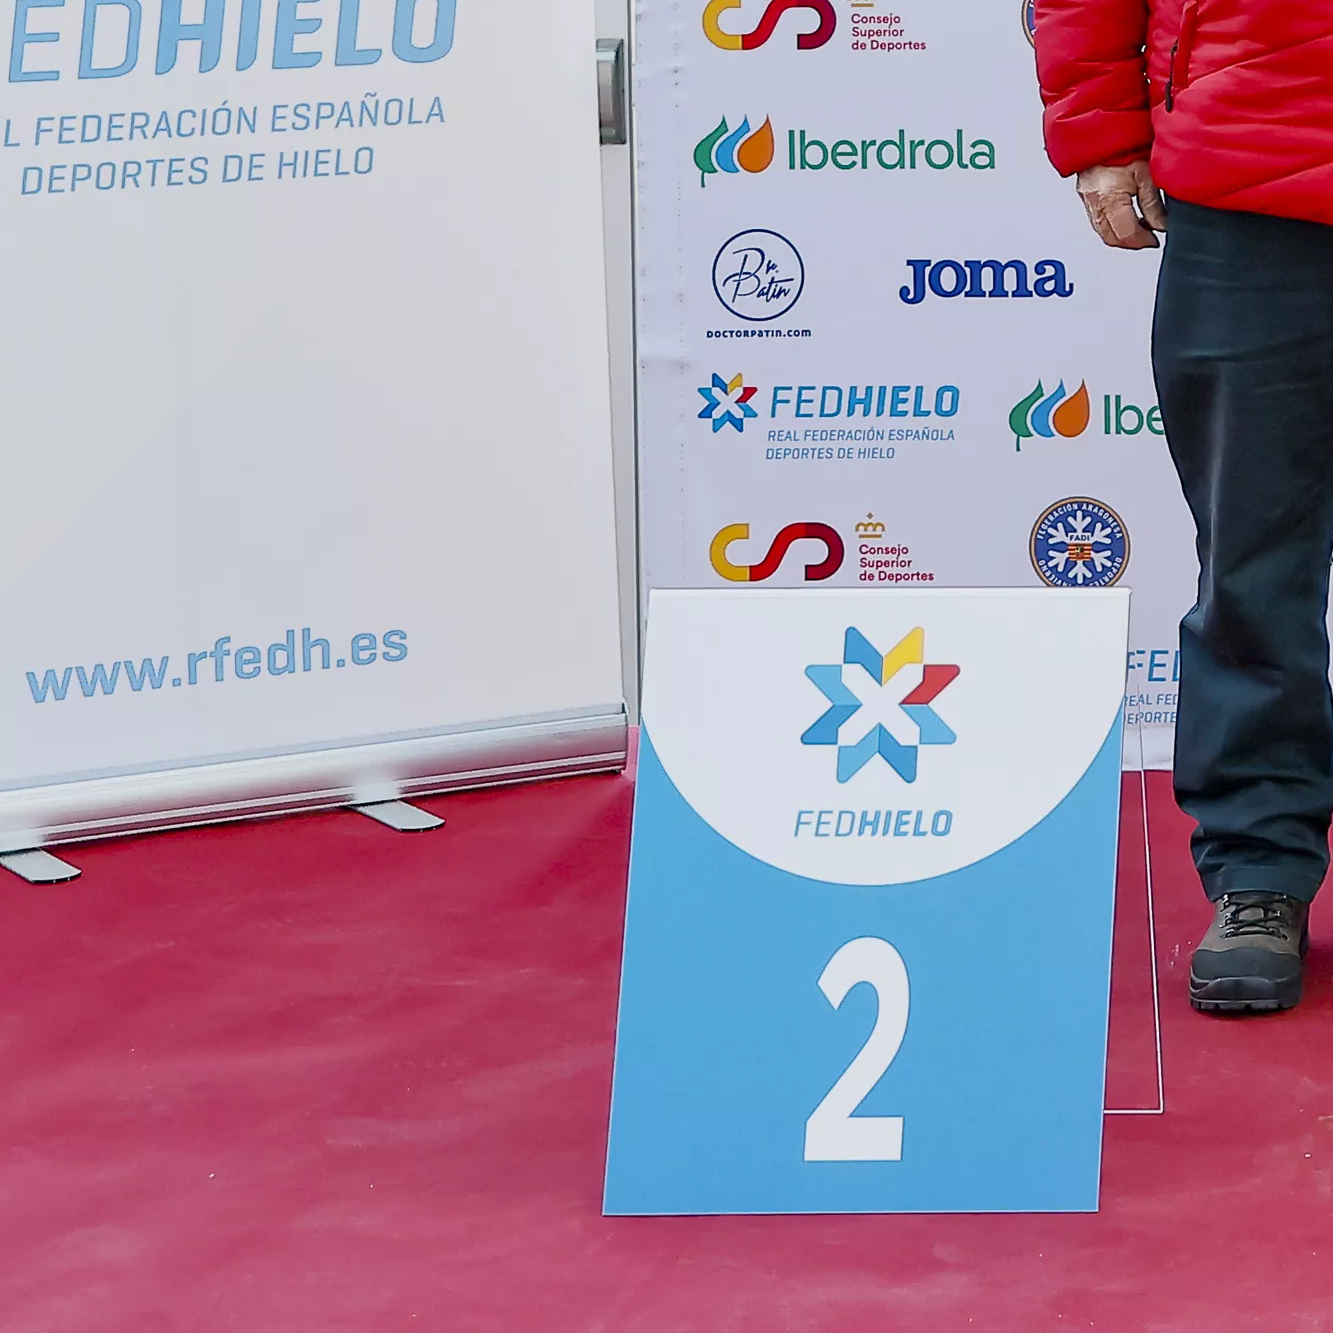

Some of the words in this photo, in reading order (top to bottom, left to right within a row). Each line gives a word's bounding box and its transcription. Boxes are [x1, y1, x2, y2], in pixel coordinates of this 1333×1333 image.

[35, 100, 257, 145] FEDERACIÓN
[271, 92, 444, 132] ESPAÑOLA
[21, 156, 208, 195] DEPORTES
[222, 153, 265, 182] DE
[278, 147, 373, 179] HIELO
[26, 627, 407, 703] www.rfedh.es
[794, 810, 952, 837] FEDHIELO
[804, 936, 910, 1161] 2
